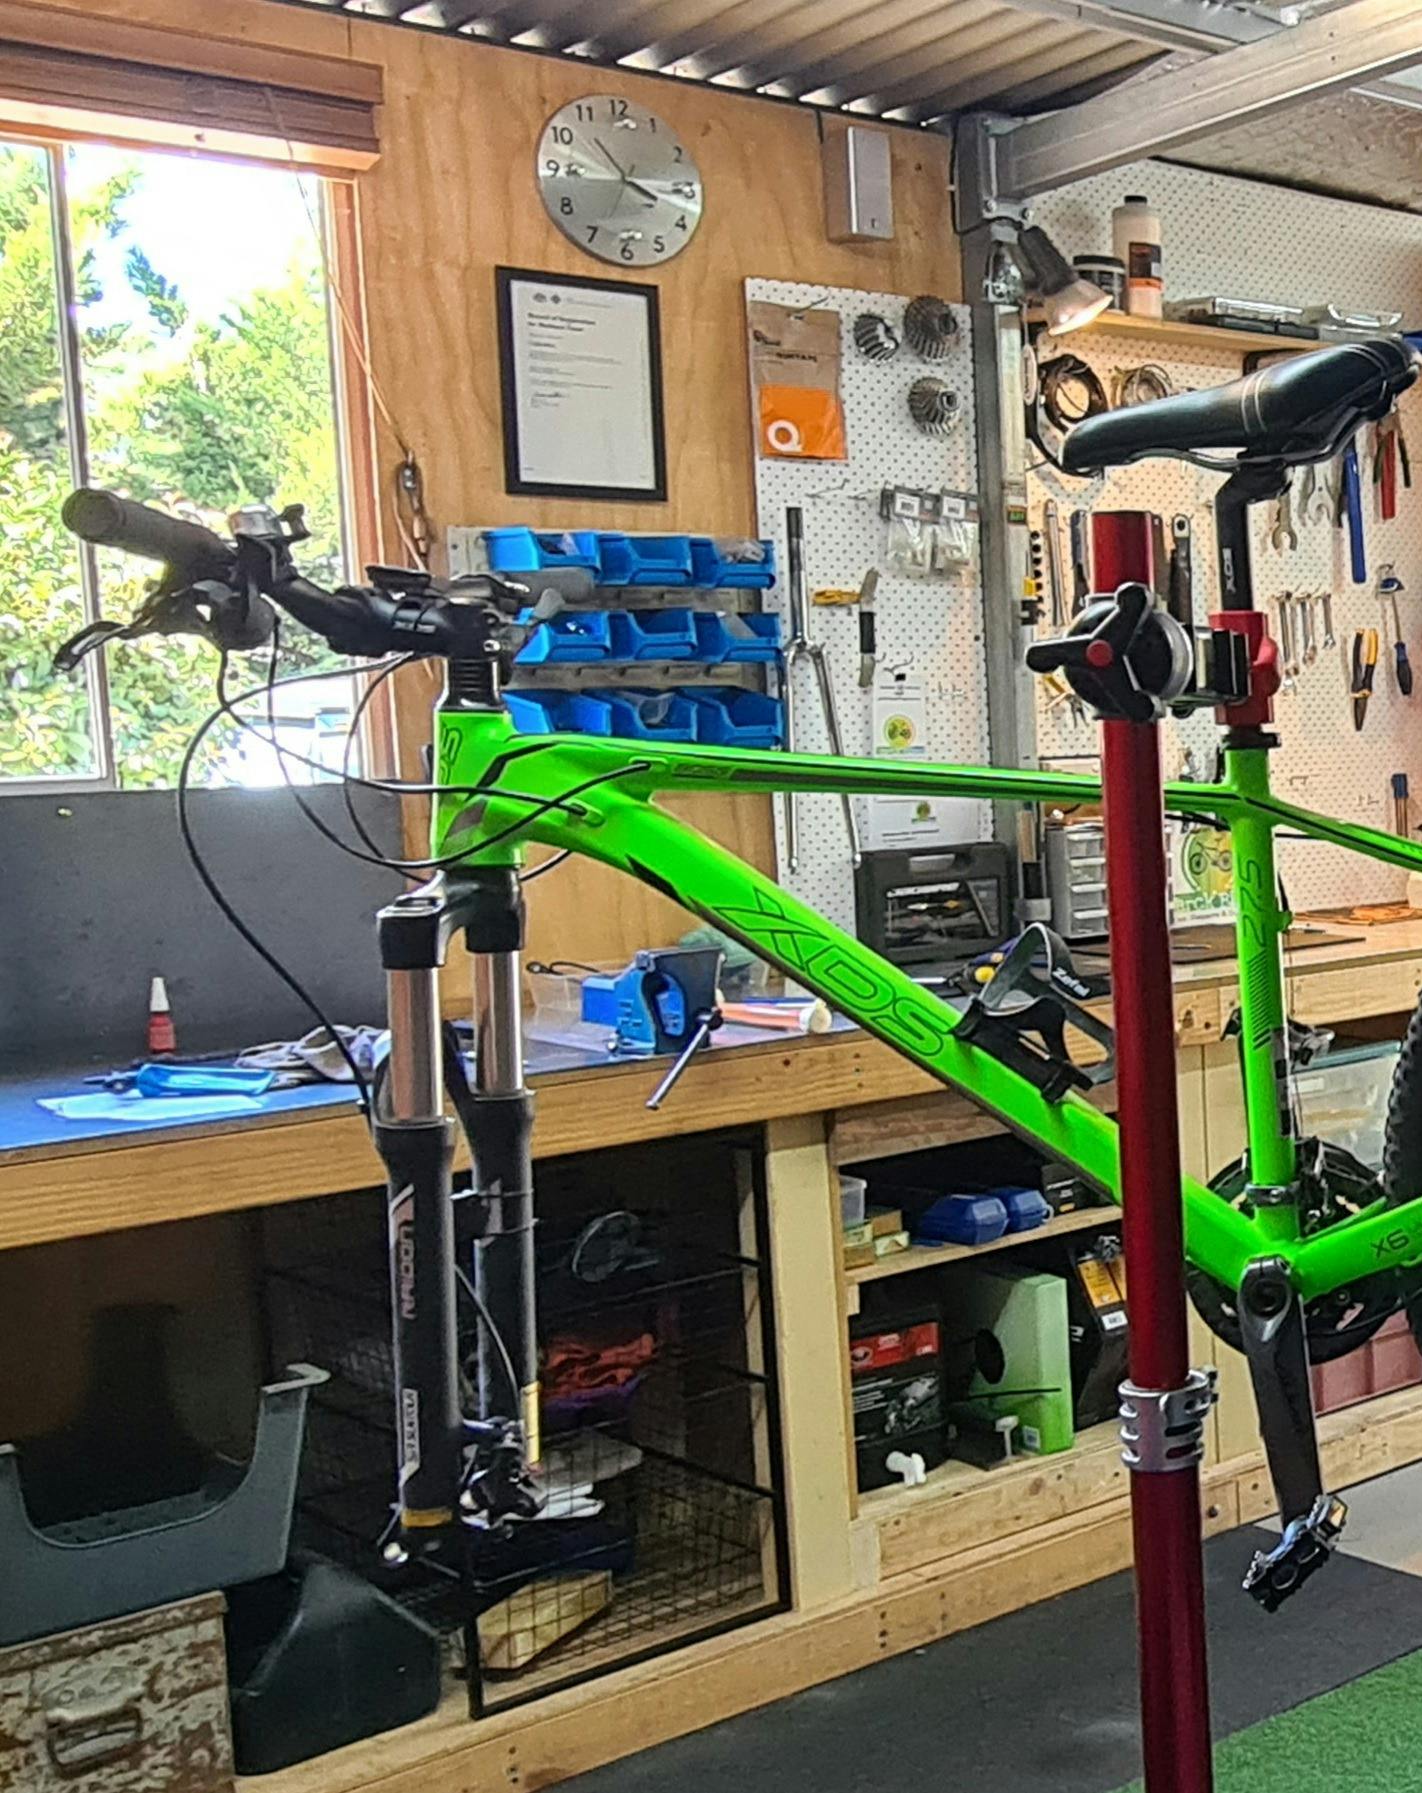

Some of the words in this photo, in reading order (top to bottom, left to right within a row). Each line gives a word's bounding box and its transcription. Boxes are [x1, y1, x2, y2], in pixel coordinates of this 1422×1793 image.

[576, 104, 593, 121] 11
[610, 99, 628, 116] 12
[649, 117, 656, 133] 1
[551, 126, 573, 145] 10
[673, 145, 683, 163] 2
[546, 159, 560, 177] 9
[560, 196, 574, 215] 8
[674, 214, 688, 232] 4
[586, 225, 599, 243] 7
[619, 242, 634, 261] 6
[653, 235, 666, 253] 5
[711, 885, 953, 1057] XDS
[1369, 1217, 1411, 1249] X6
